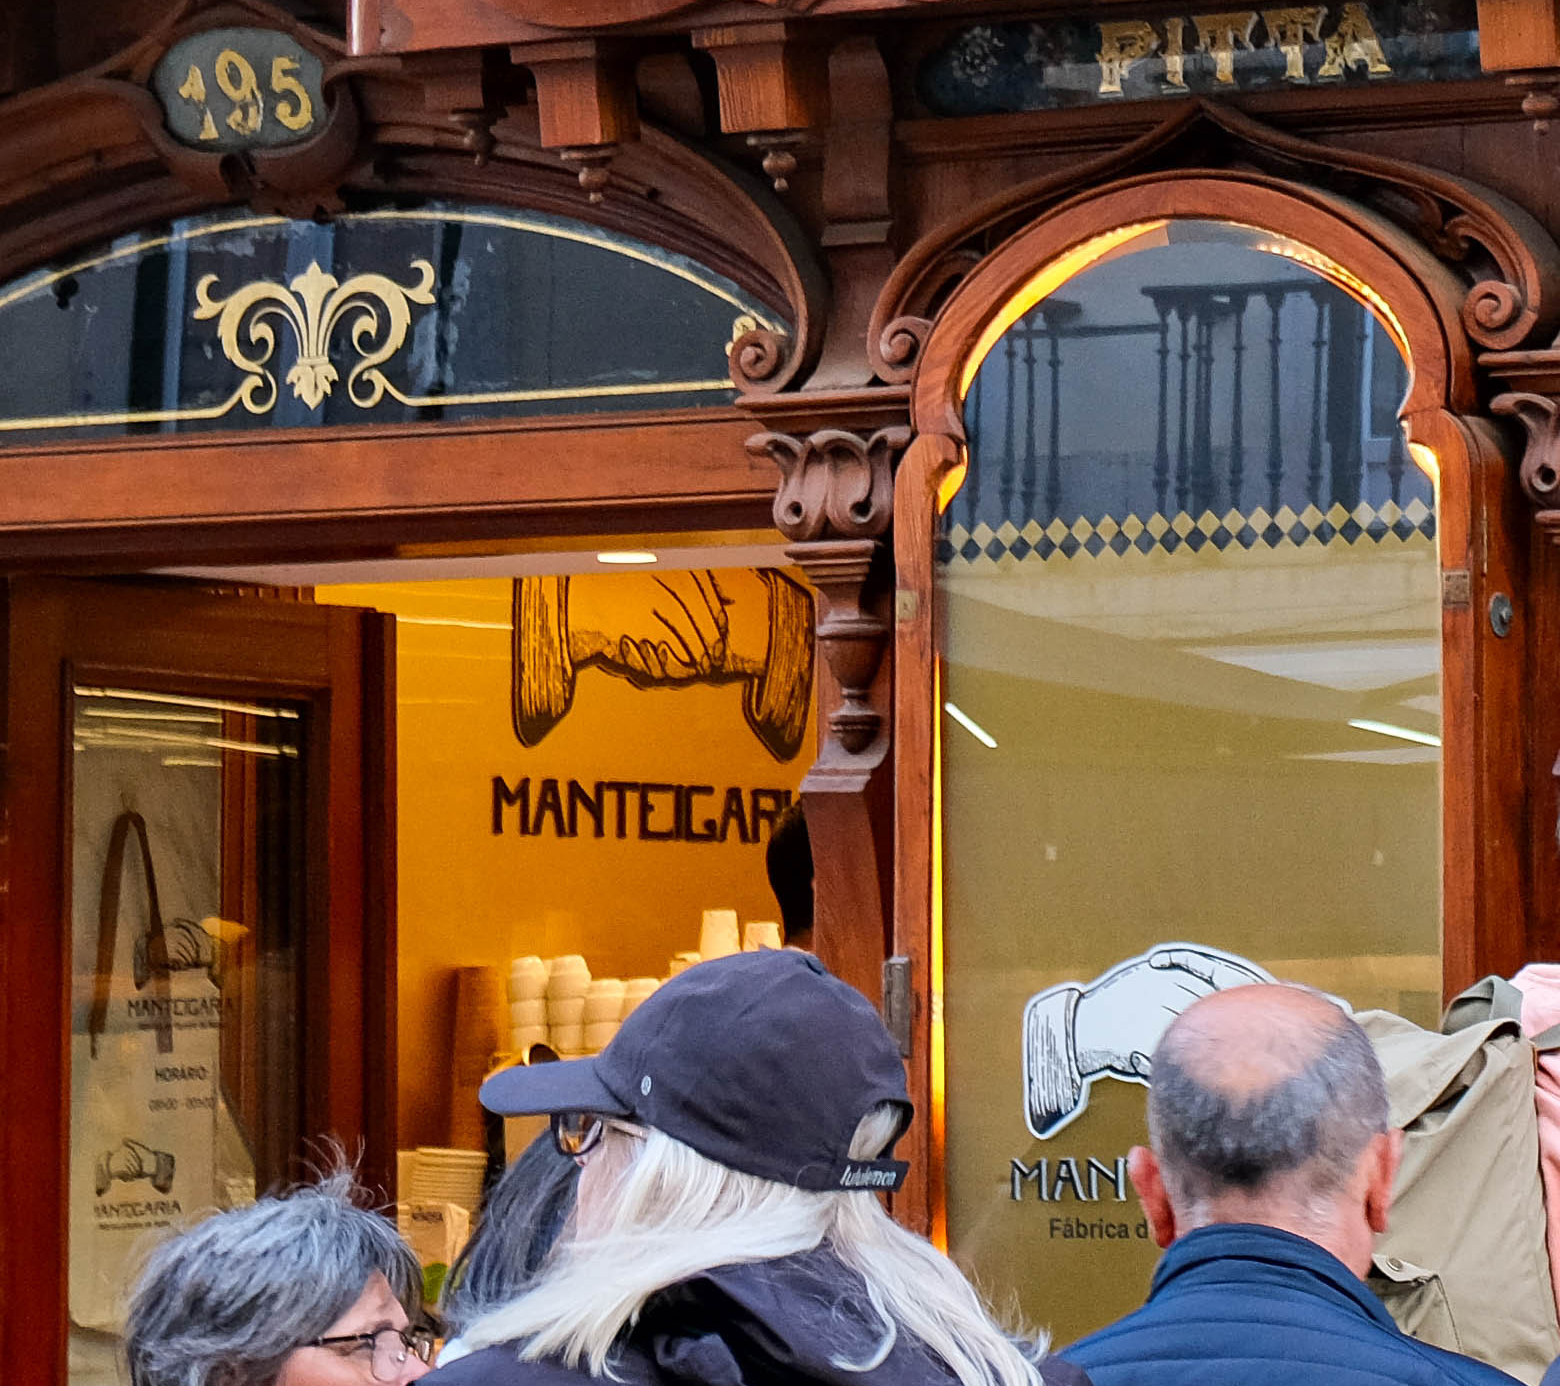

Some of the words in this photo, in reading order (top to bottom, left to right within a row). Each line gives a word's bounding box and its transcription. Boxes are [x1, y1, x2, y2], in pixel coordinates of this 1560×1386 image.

[1095, 2, 1392, 97] PITTA
[177, 47, 316, 142] 195
[1010, 1156, 1128, 1202] MAN
[1049, 1217, 1130, 1240] Fábrica
[1135, 1217, 1149, 1240] d
